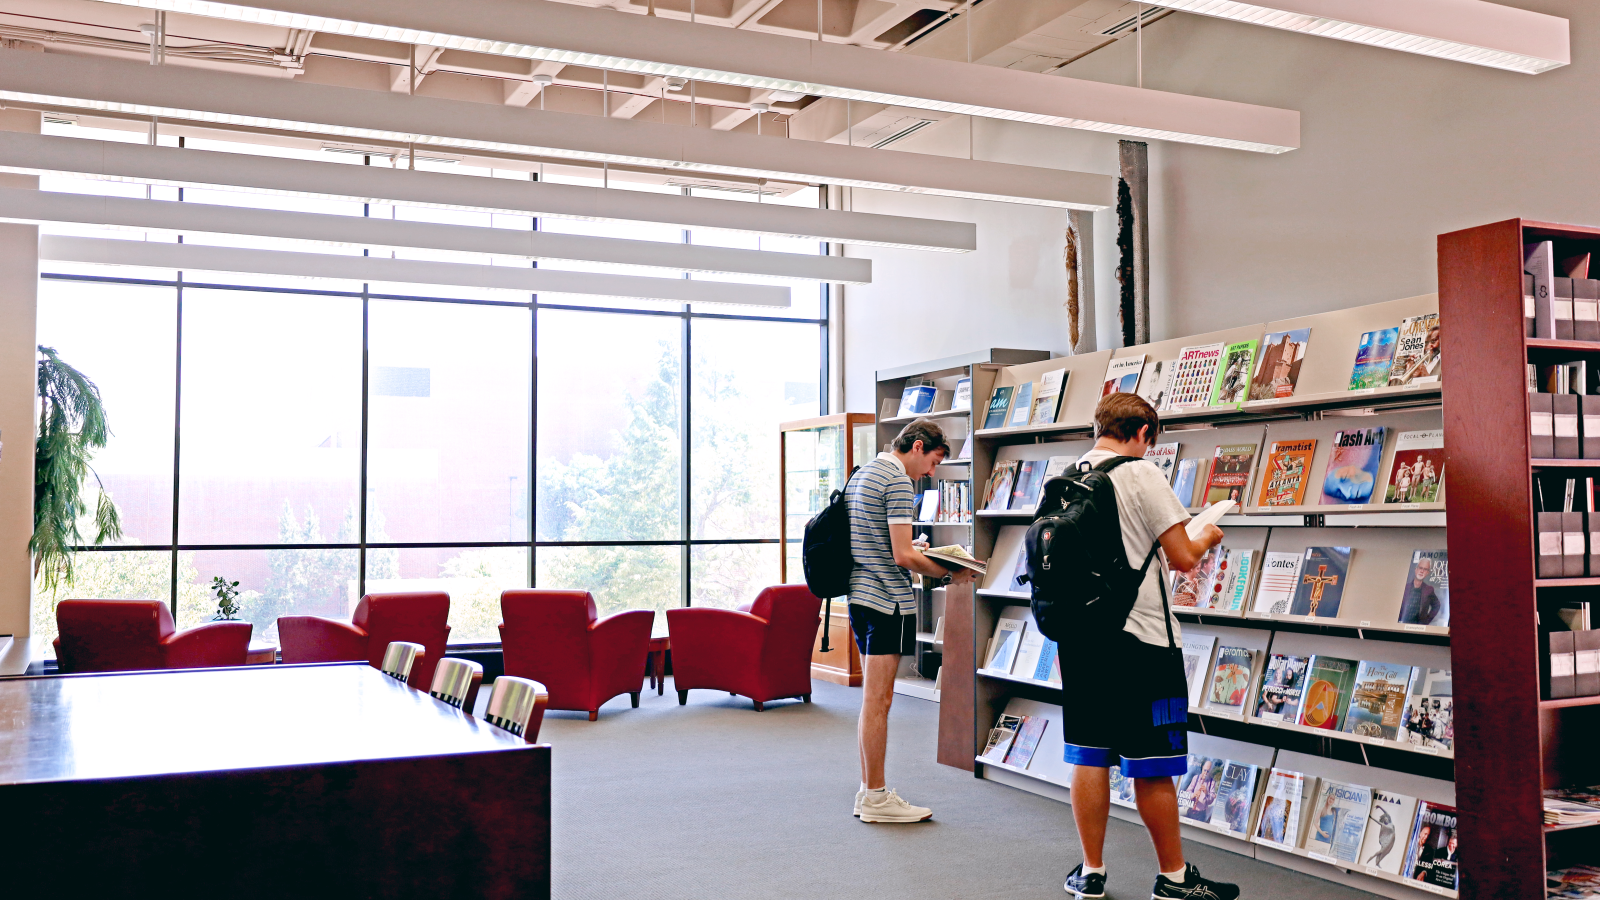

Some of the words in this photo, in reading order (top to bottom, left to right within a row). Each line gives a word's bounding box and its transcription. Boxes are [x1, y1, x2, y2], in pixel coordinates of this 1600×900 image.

[1400, 336, 1422, 345] Sean
[1400, 343, 1424, 351] Jones
[1181, 349, 1220, 361] ARTnews
[1336, 430, 1363, 447] lash
[1364, 428, 1384, 446] Art
[1145, 449, 1156, 457] rts
[1156, 448, 1163, 456] of
[1162, 446, 1176, 456] Asia
[1275, 442, 1313, 453] ramatist
[1269, 476, 1301, 488] ATLANTA
[1433, 560, 1448, 570] JOH
[1182, 643, 1210, 651] RLINGTON
[1366, 667, 1385, 677] Horn
[1385, 670, 1399, 680] Call
[1224, 764, 1251, 782] CLAY
[1422, 811, 1457, 828] ROMBO
[1415, 860, 1434, 870] ALESSI
[1433, 859, 1453, 870] COREA
